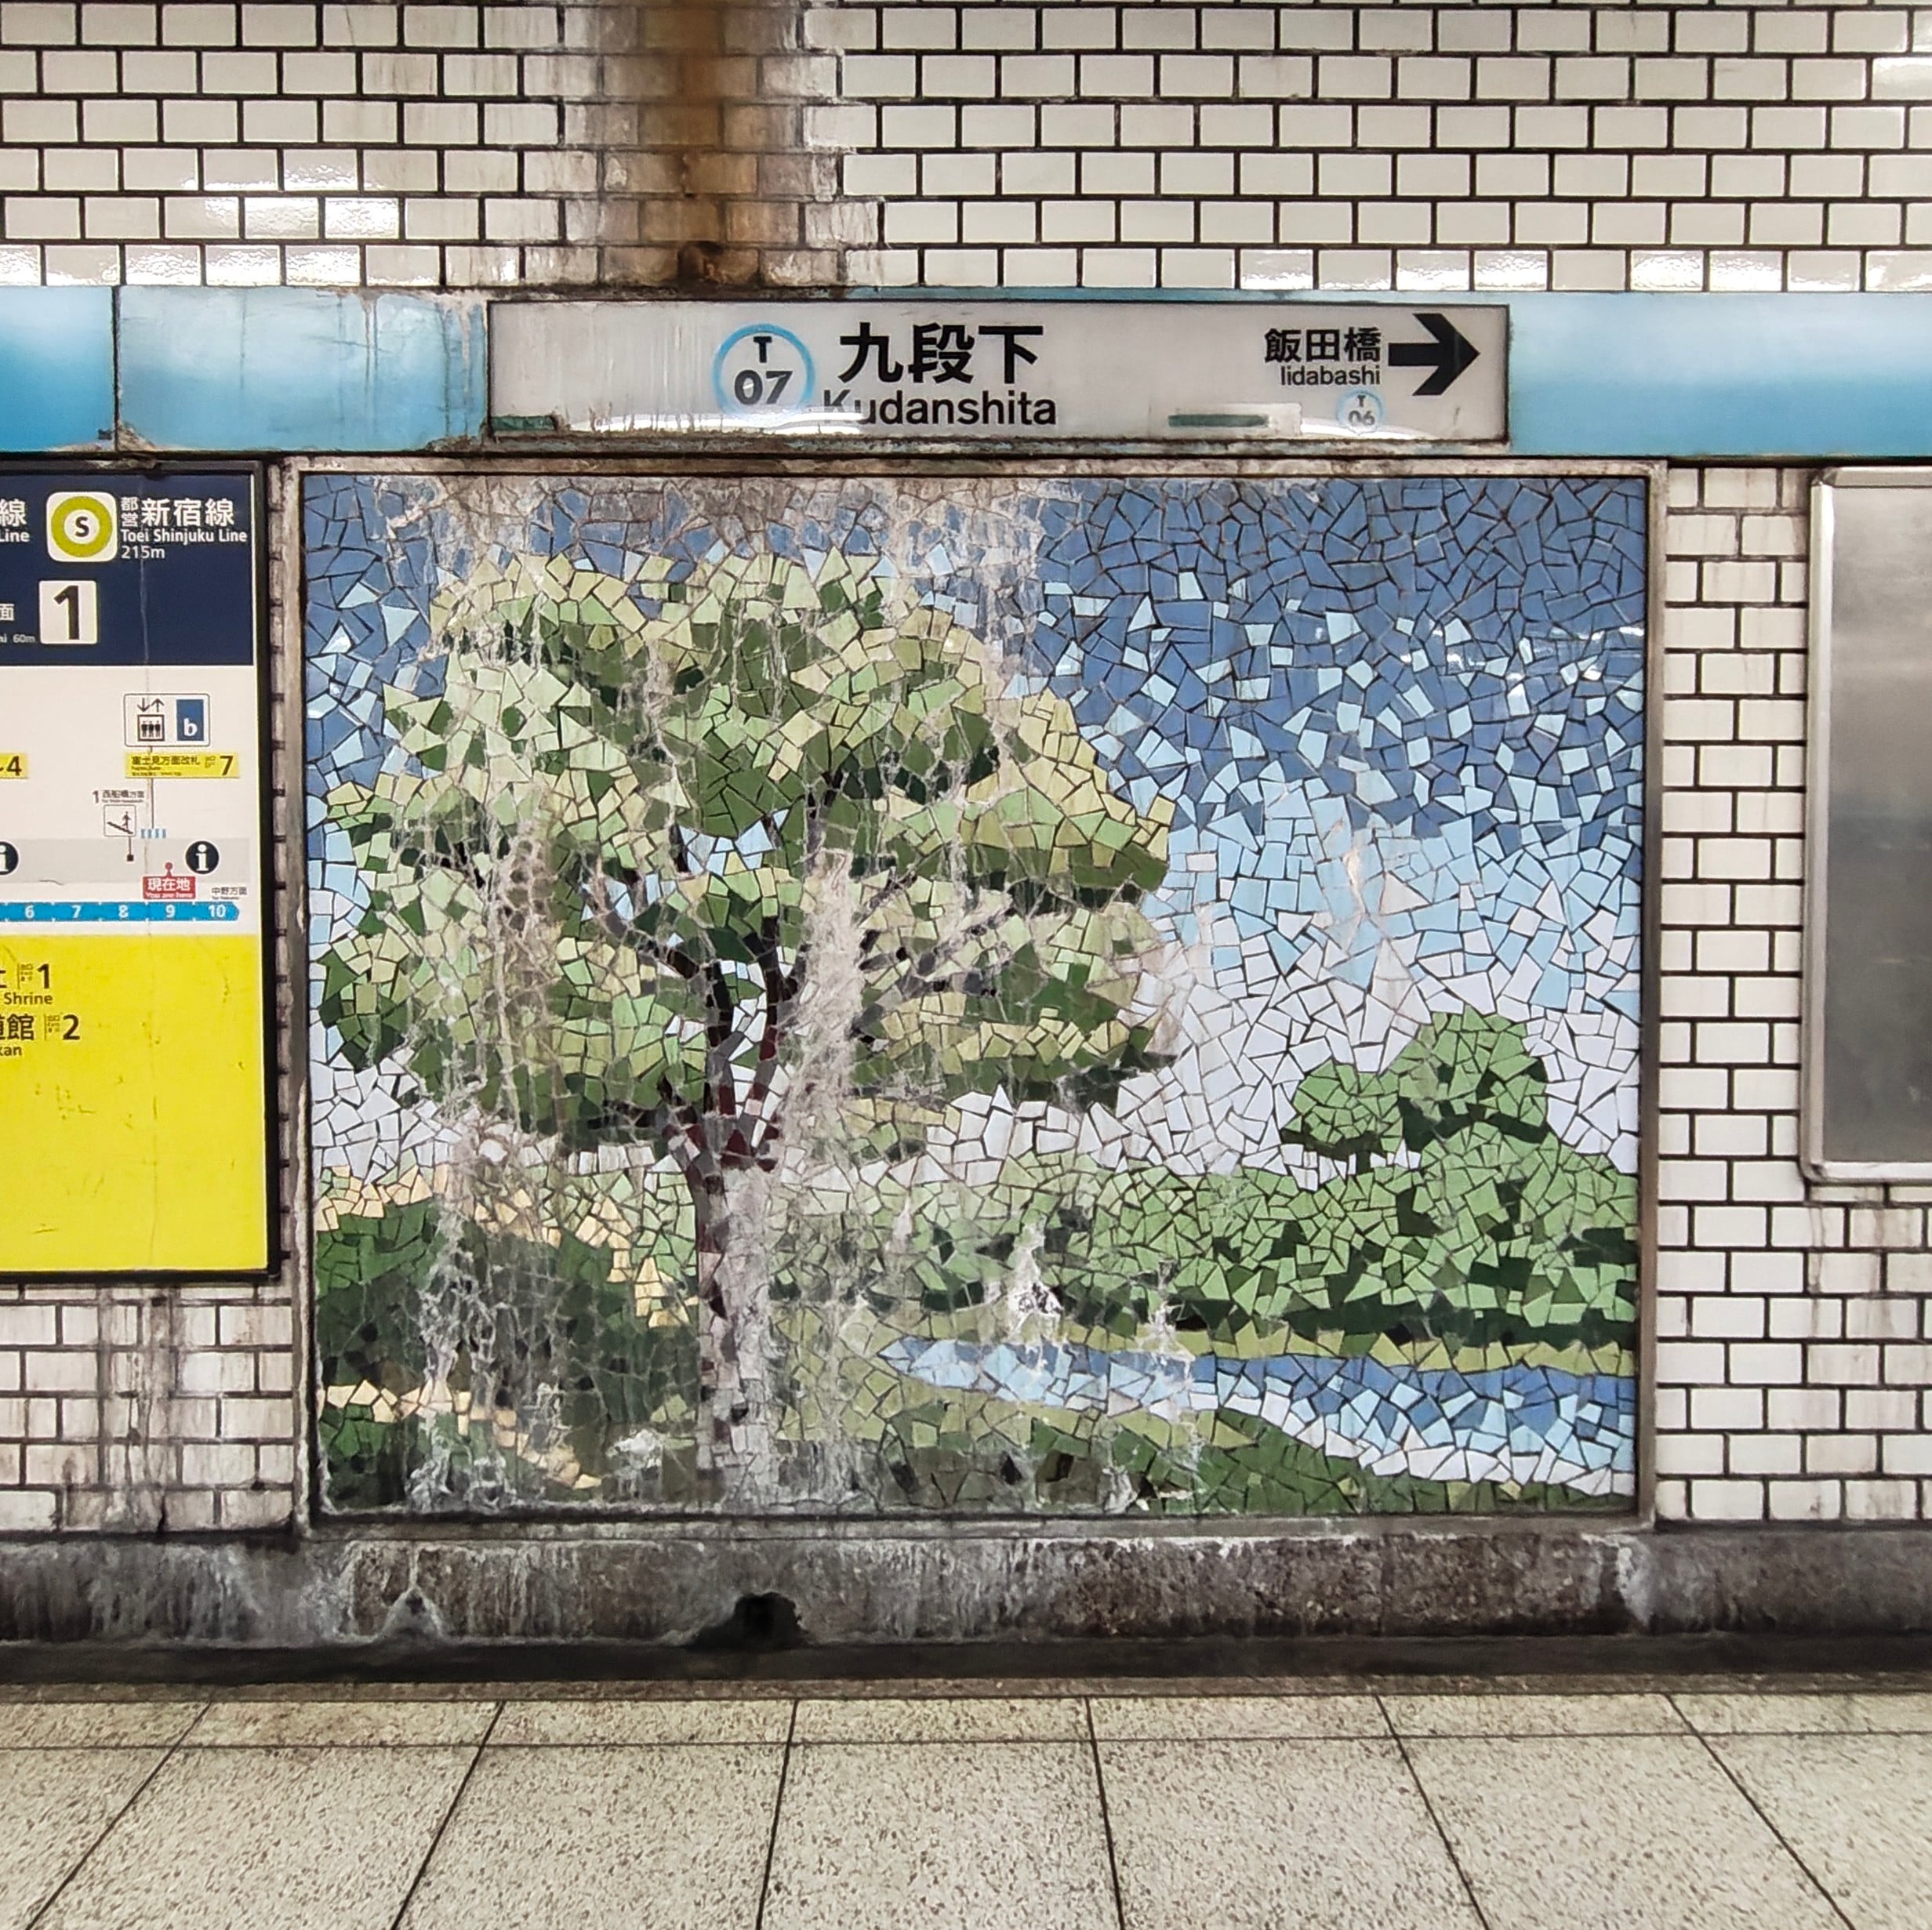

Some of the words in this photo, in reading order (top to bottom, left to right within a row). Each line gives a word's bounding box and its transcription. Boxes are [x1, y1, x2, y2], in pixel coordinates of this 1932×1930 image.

[753, 336, 773, 363] T
[837, 321, 1044, 385] 九段下
[1264, 327, 1382, 362] 飯田橋
[734, 370, 794, 405] 07
[823, 390, 1056, 425] Kudanshita
[141, 498, 234, 527] 新宿線
[74, 516, 90, 537] S
[121, 529, 150, 542] Toei
[153, 529, 214, 546] Shinjuku
[218, 529, 248, 542] Line
[121, 546, 165, 560] 215m
[53, 585, 81, 640] 1
[13, 633, 35, 644] 60m
[183, 718, 198, 736] b
[220, 755, 234, 776] 7
[93, 790, 99, 804] 1
[147, 878, 191, 891] 現在地
[24, 905, 35, 919] 6
[72, 905, 82, 919] 7
[118, 905, 129, 919] 8
[165, 905, 176, 918] 9
[208, 905, 227, 918] 10
[36, 963, 50, 989] 1
[4, 992, 53, 1004] Shrine
[63, 1014, 81, 1040] 2
